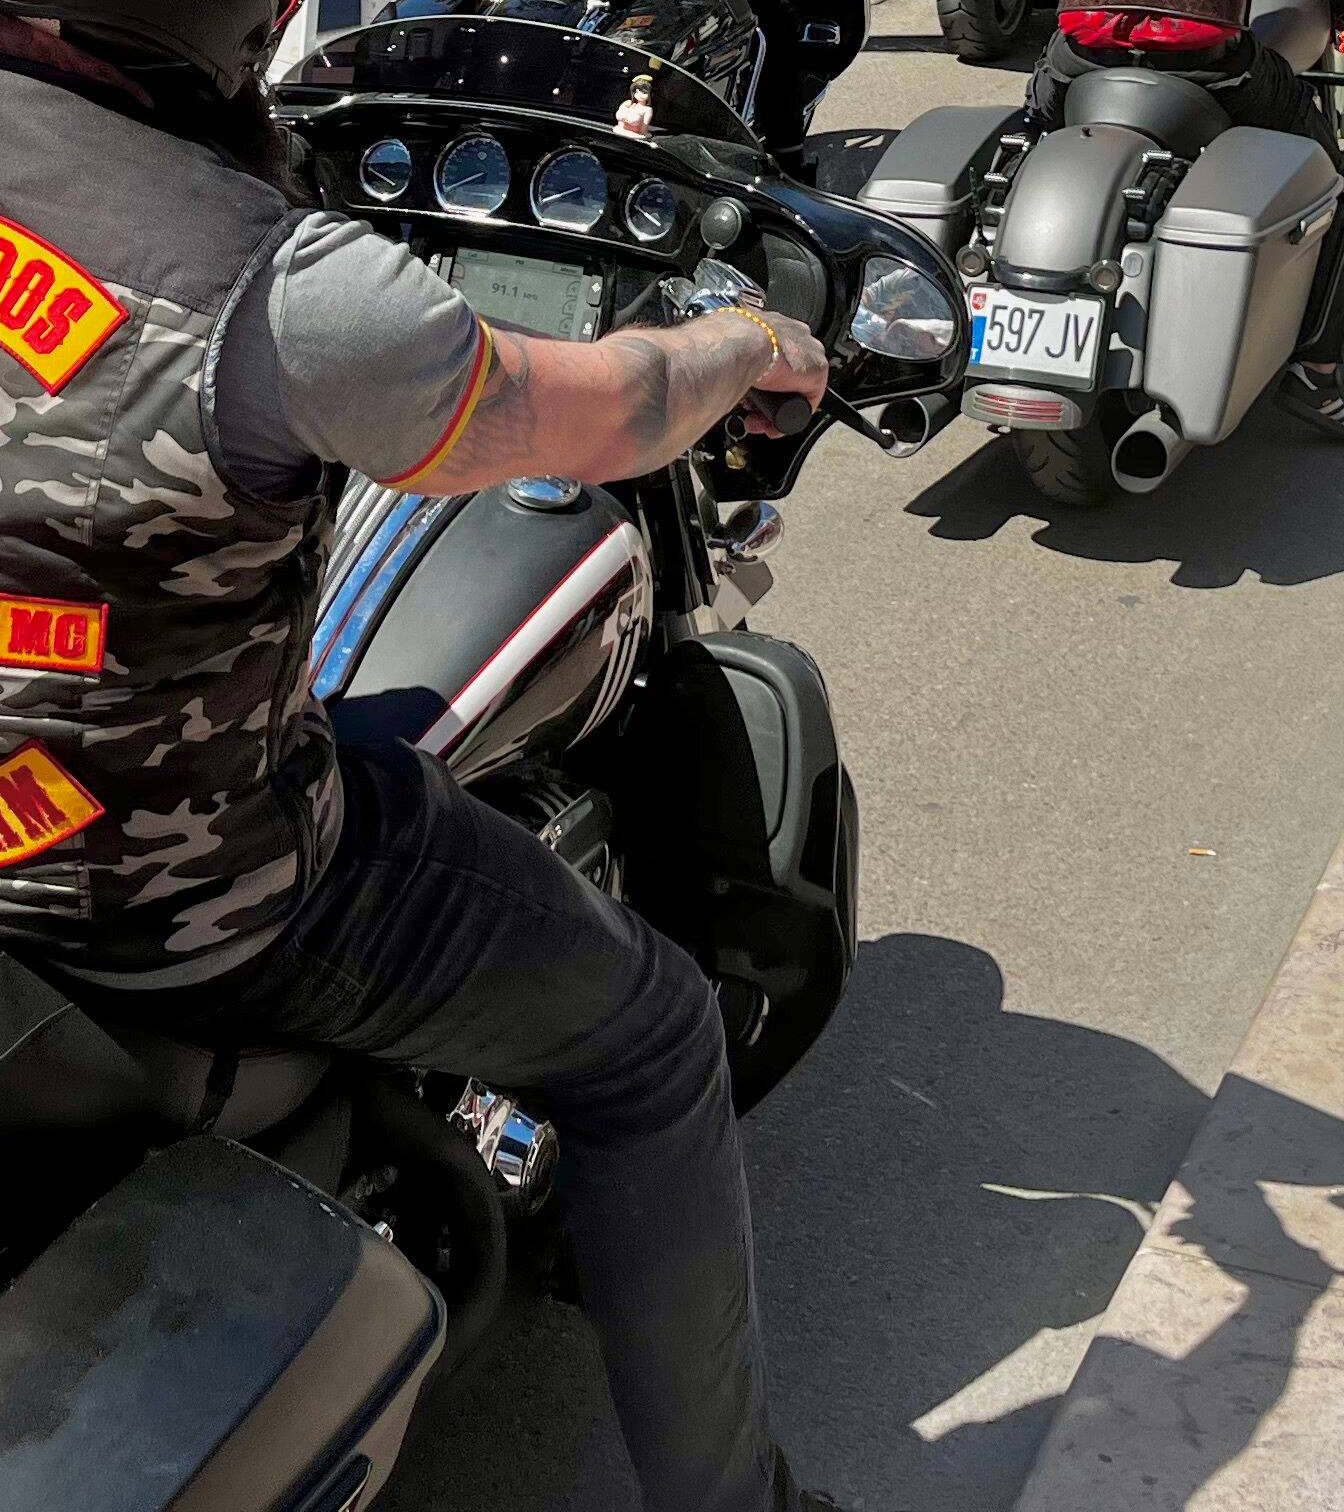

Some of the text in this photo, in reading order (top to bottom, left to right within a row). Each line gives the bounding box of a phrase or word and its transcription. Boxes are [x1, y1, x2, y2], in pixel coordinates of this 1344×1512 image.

[492, 282, 518, 298] 91.1
[986, 303, 1095, 363] 597 JV
[6, 604, 91, 662] MC
